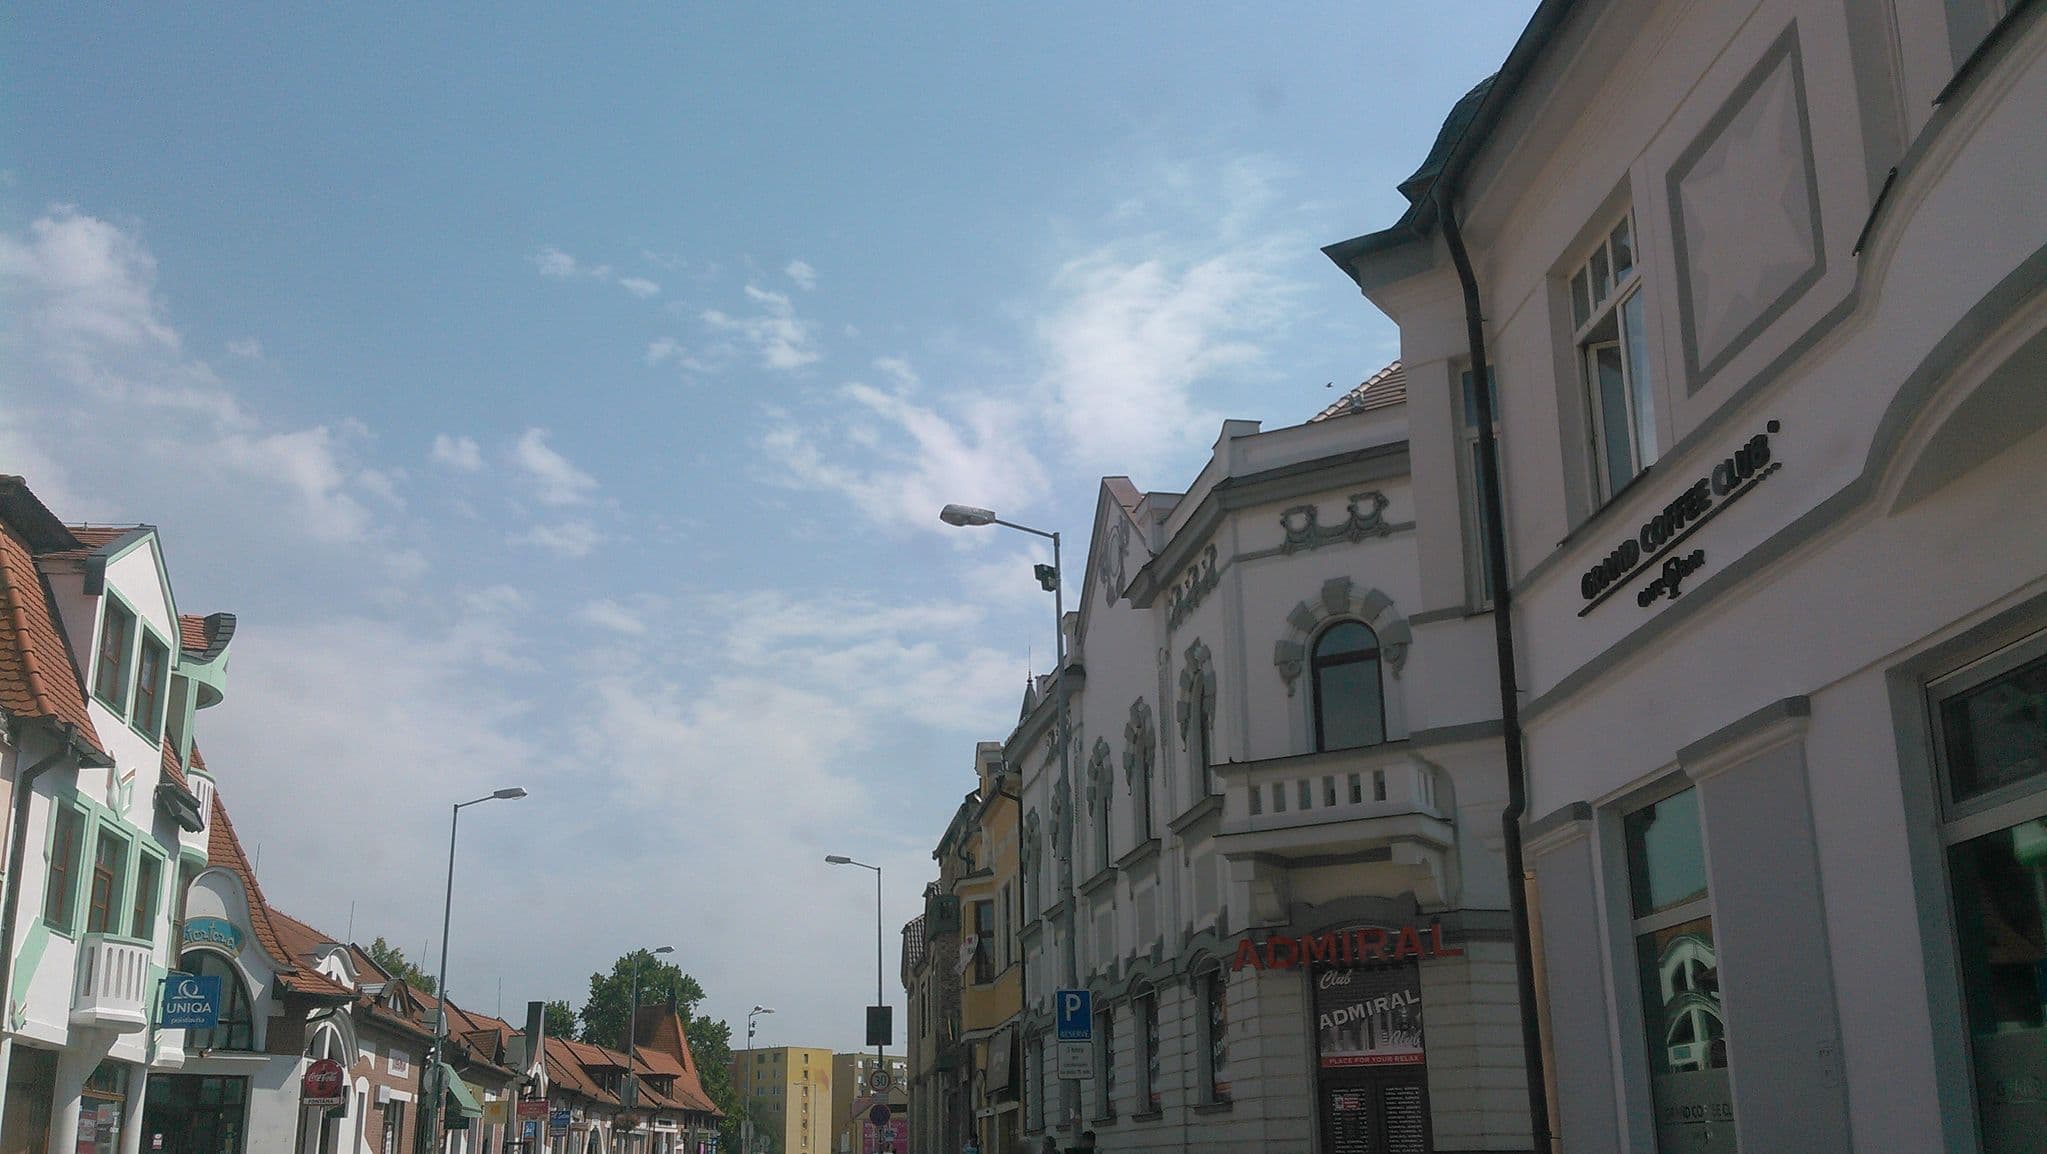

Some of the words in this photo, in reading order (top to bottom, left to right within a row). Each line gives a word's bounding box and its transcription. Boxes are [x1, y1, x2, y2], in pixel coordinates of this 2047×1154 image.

[1581, 539, 1640, 600] GRAND
[1640, 478, 1712, 553] COFFEE
[1711, 434, 1770, 496] CLUB
[1232, 921, 1465, 972] ADMIRAL
[1319, 968, 1353, 990] Club
[166, 1002, 212, 1014] UNIQA
[1065, 993, 1082, 1022] P
[1319, 989, 1421, 1031] ADMIRAL
[1329, 1057, 1353, 1065] PLACE
[1355, 1056, 1370, 1064] FOR
[1372, 1055, 1393, 1063] YOUR
[1395, 1055, 1419, 1063] RELAX
[874, 1075, 886, 1087] 30
